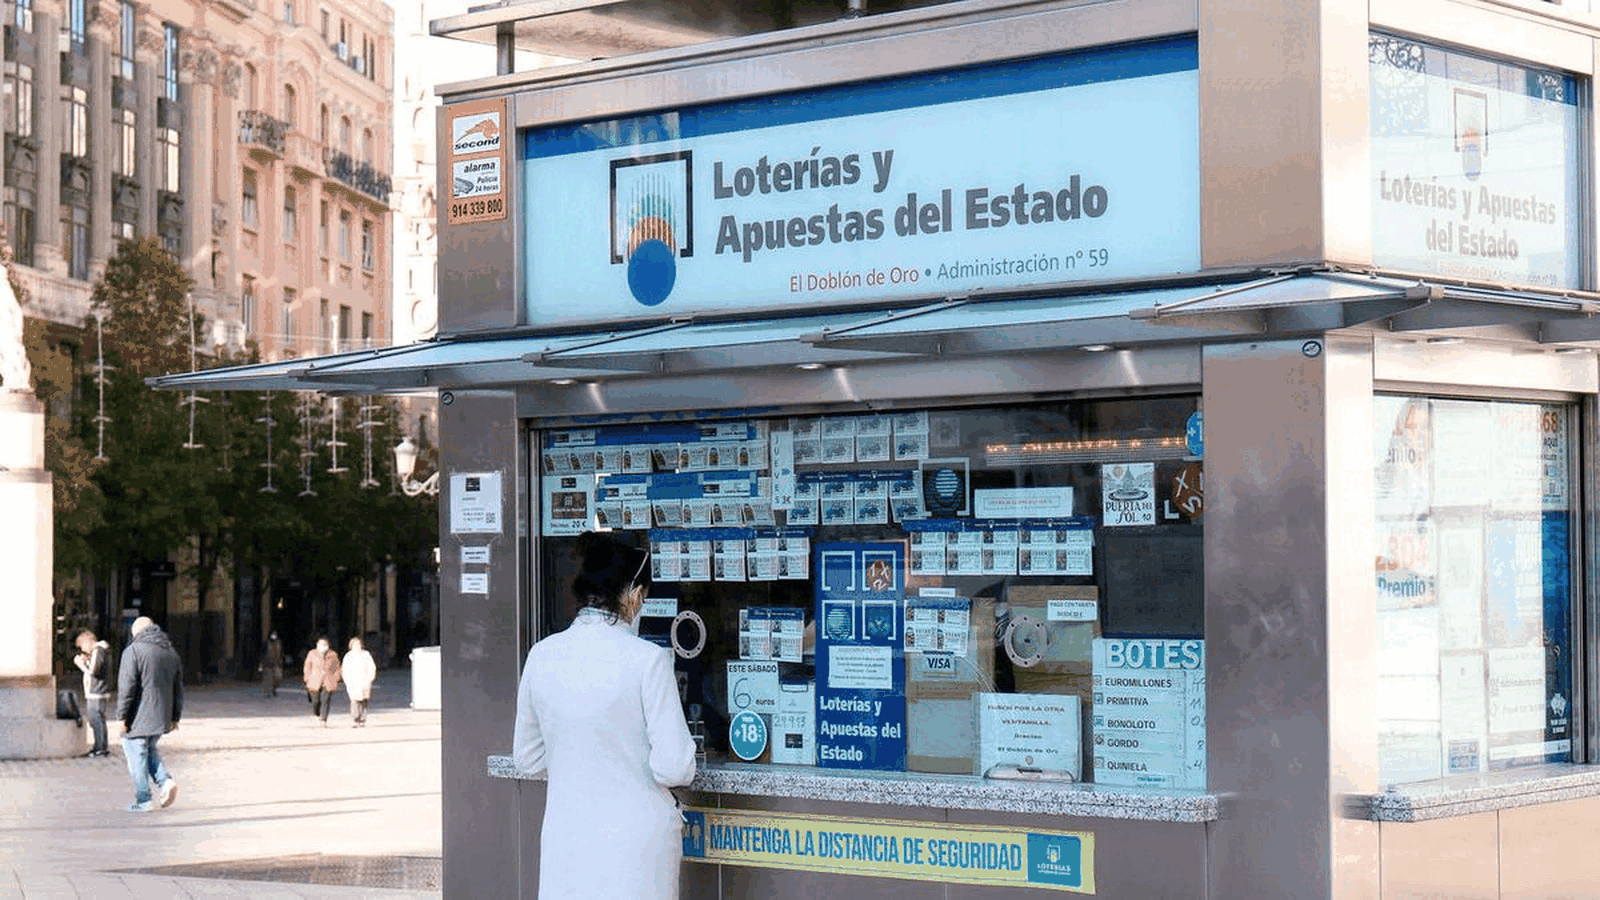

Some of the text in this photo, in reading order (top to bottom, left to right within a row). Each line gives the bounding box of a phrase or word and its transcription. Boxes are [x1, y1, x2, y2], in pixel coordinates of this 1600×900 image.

[455, 136, 500, 150] second
[463, 162, 496, 173] alarma
[713, 147, 894, 199] Loterías y
[1380, 170, 1556, 225] Loterías y Apuestas
[452, 203, 468, 218] 914
[469, 201, 485, 216] 339
[715, 175, 1109, 263] Apuestas del Estado
[1426, 218, 1519, 260] del Estado
[790, 275, 802, 293] El
[807, 268, 862, 291] Doblón
[866, 269, 886, 286] de
[890, 266, 919, 284] Oro
[937, 251, 1060, 280] Administración
[1089, 248, 1109, 267] 59
[1377, 575, 1427, 598] Premio
[927, 658, 950, 669] VISA
[1108, 640, 1200, 669] BOTES
[729, 664, 746, 673] ESTE
[1105, 678, 1172, 688] EUROMILLONES
[733, 678, 751, 708] 6
[1106, 697, 1149, 706] PRIMITIVA
[819, 695, 882, 716] Loterías y
[820, 720, 902, 740] Apuestas del
[1107, 719, 1156, 729] BONOLOTO
[1107, 738, 1139, 748] GORDO
[821, 744, 863, 761] Estado
[1107, 761, 1148, 772] QUINIELA
[709, 824, 1022, 872] MANTENGA LA DISTANCIA DE SEGURIDAD
